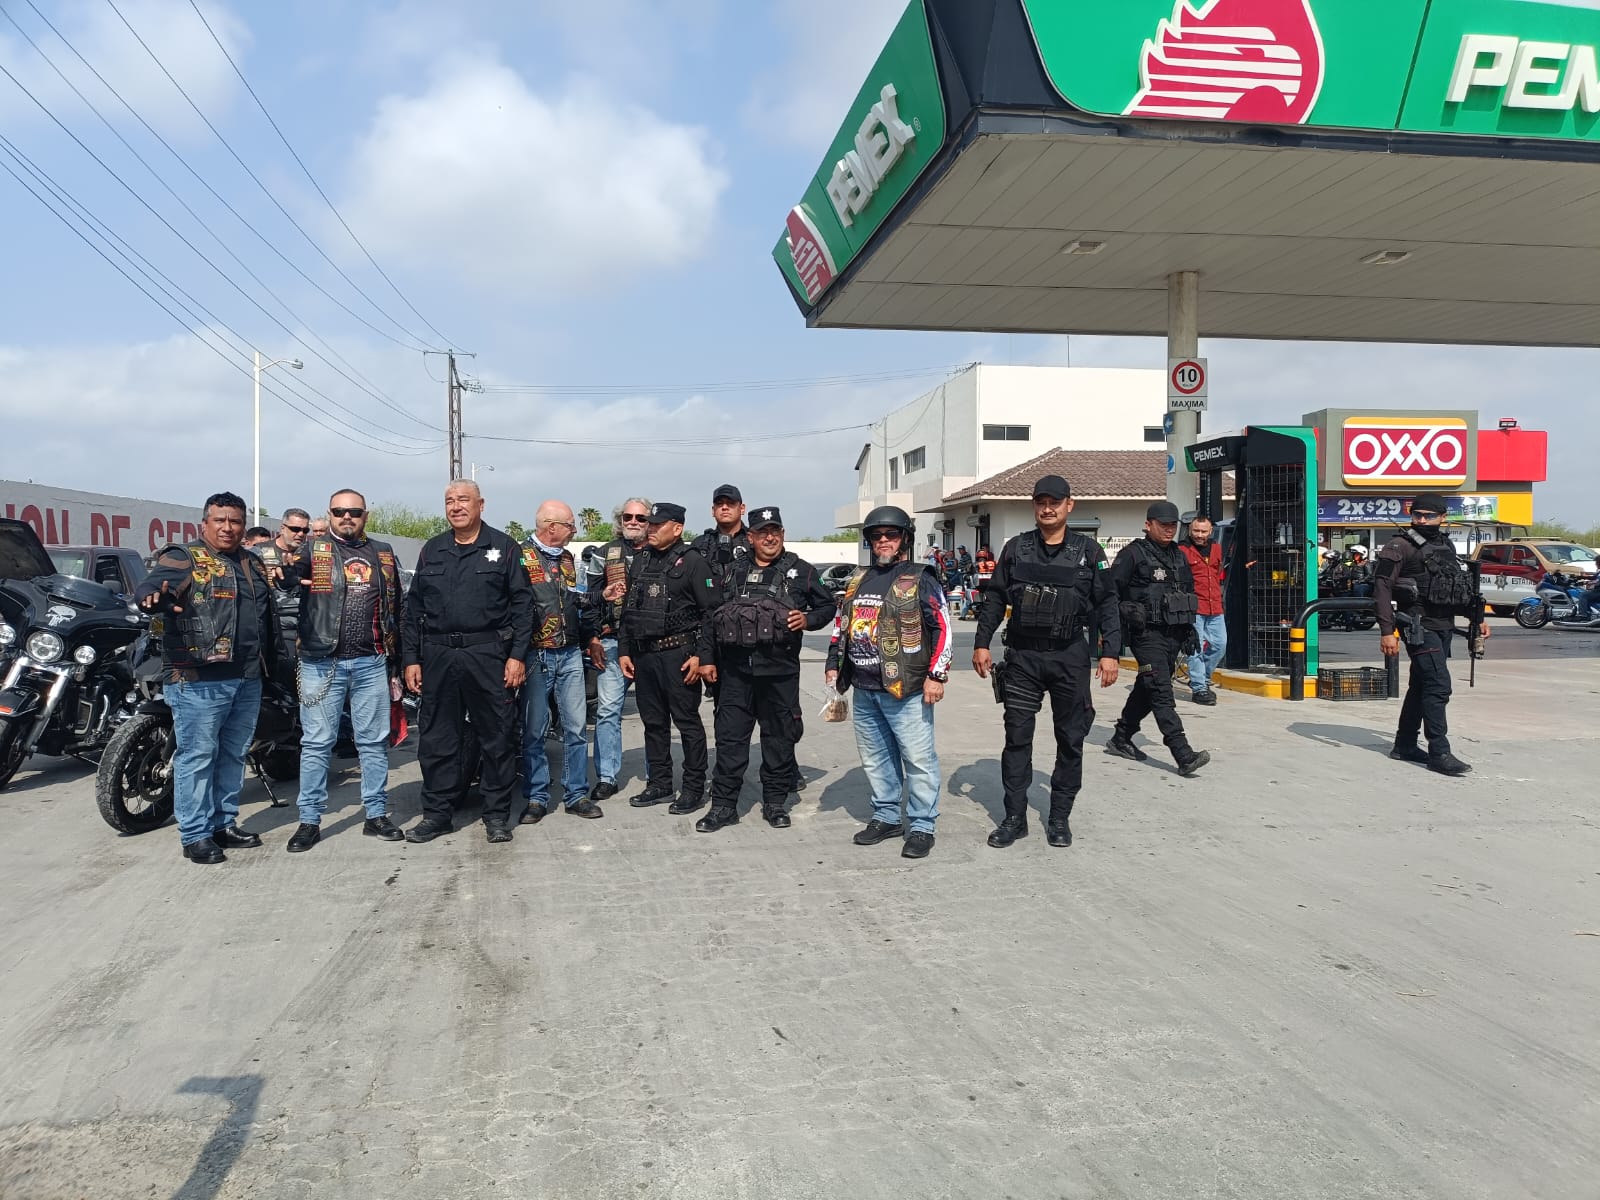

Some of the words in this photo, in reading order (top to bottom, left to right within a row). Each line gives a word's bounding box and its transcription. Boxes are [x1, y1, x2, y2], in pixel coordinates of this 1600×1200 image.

[826, 83, 915, 228] PEMEX
[1179, 369, 1197, 382] 10
[1171, 400, 1205, 408] MAXIMA
[1194, 447, 1224, 462] PEMEX
[1349, 432, 1462, 471] OXXO
